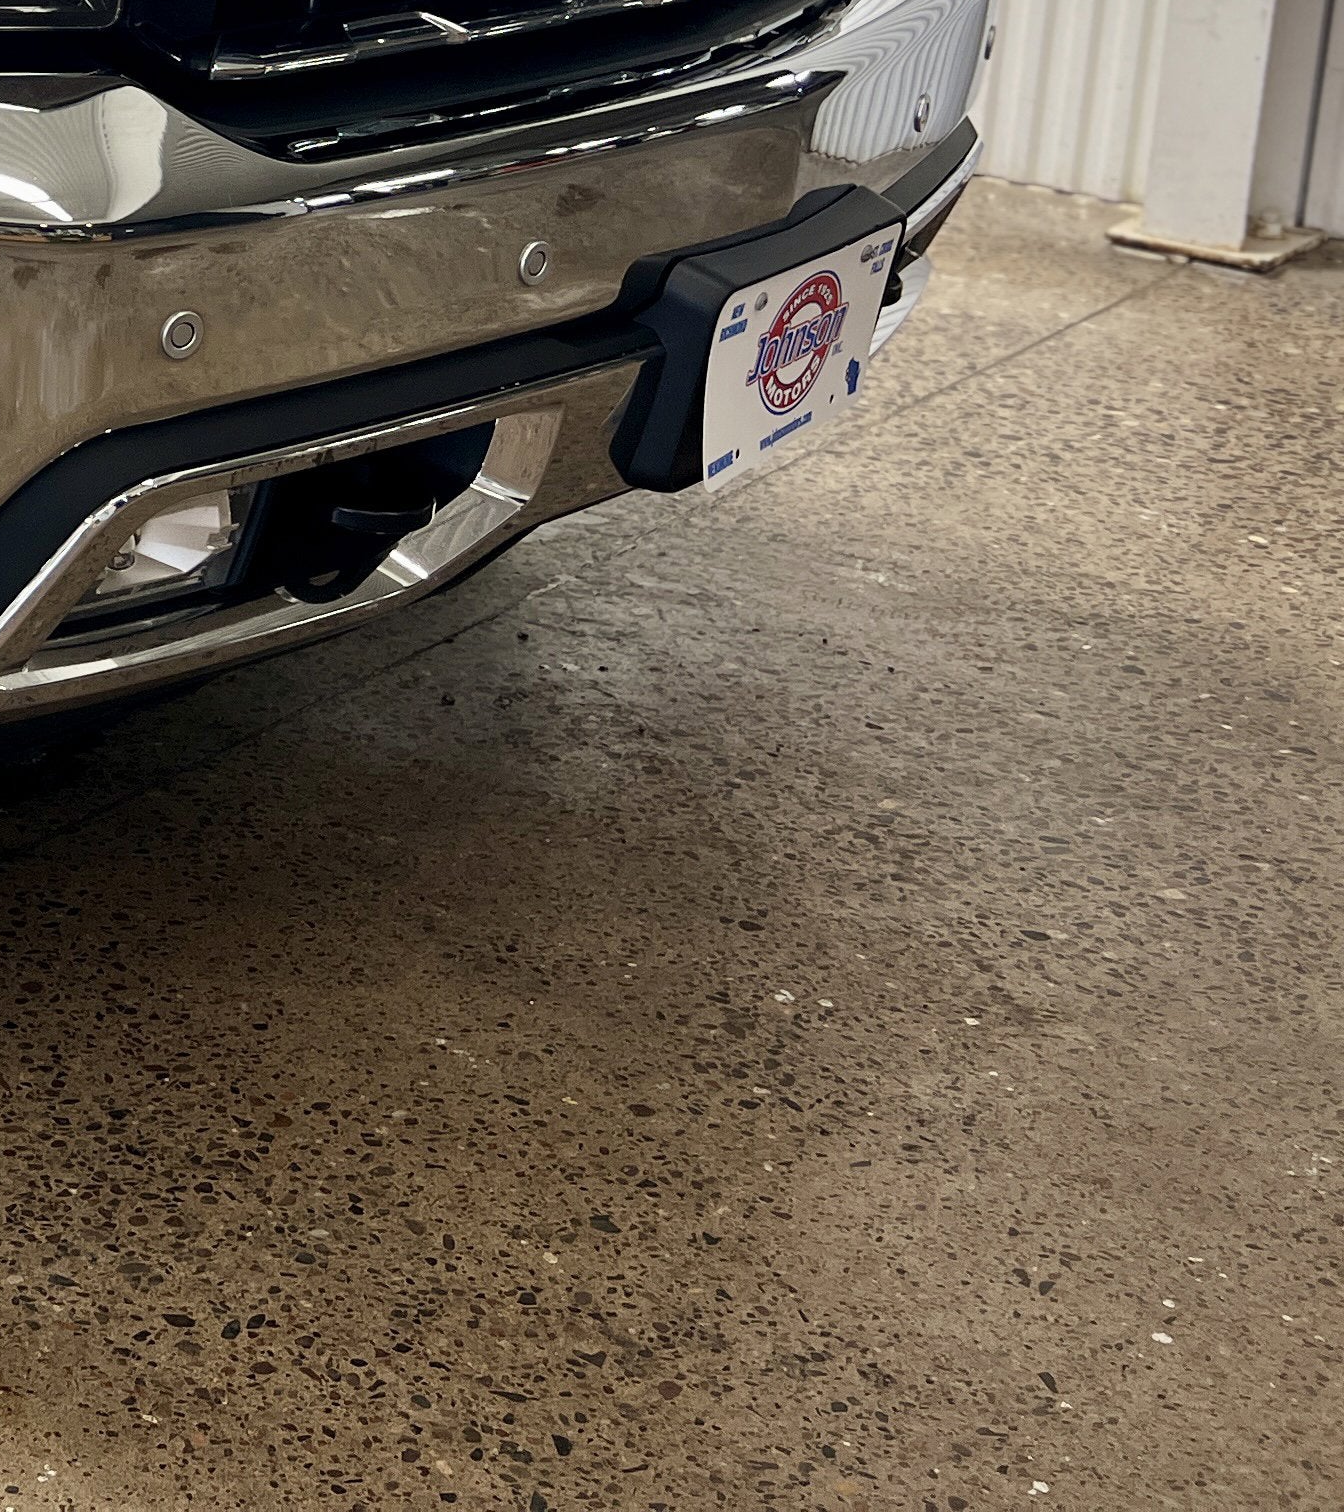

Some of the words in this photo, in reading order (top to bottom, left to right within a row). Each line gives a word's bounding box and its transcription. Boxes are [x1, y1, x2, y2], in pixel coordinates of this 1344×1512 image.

[782, 284, 816, 322] SINCE
[745, 302, 849, 387] Johnson
[765, 355, 820, 406] MOTORS
